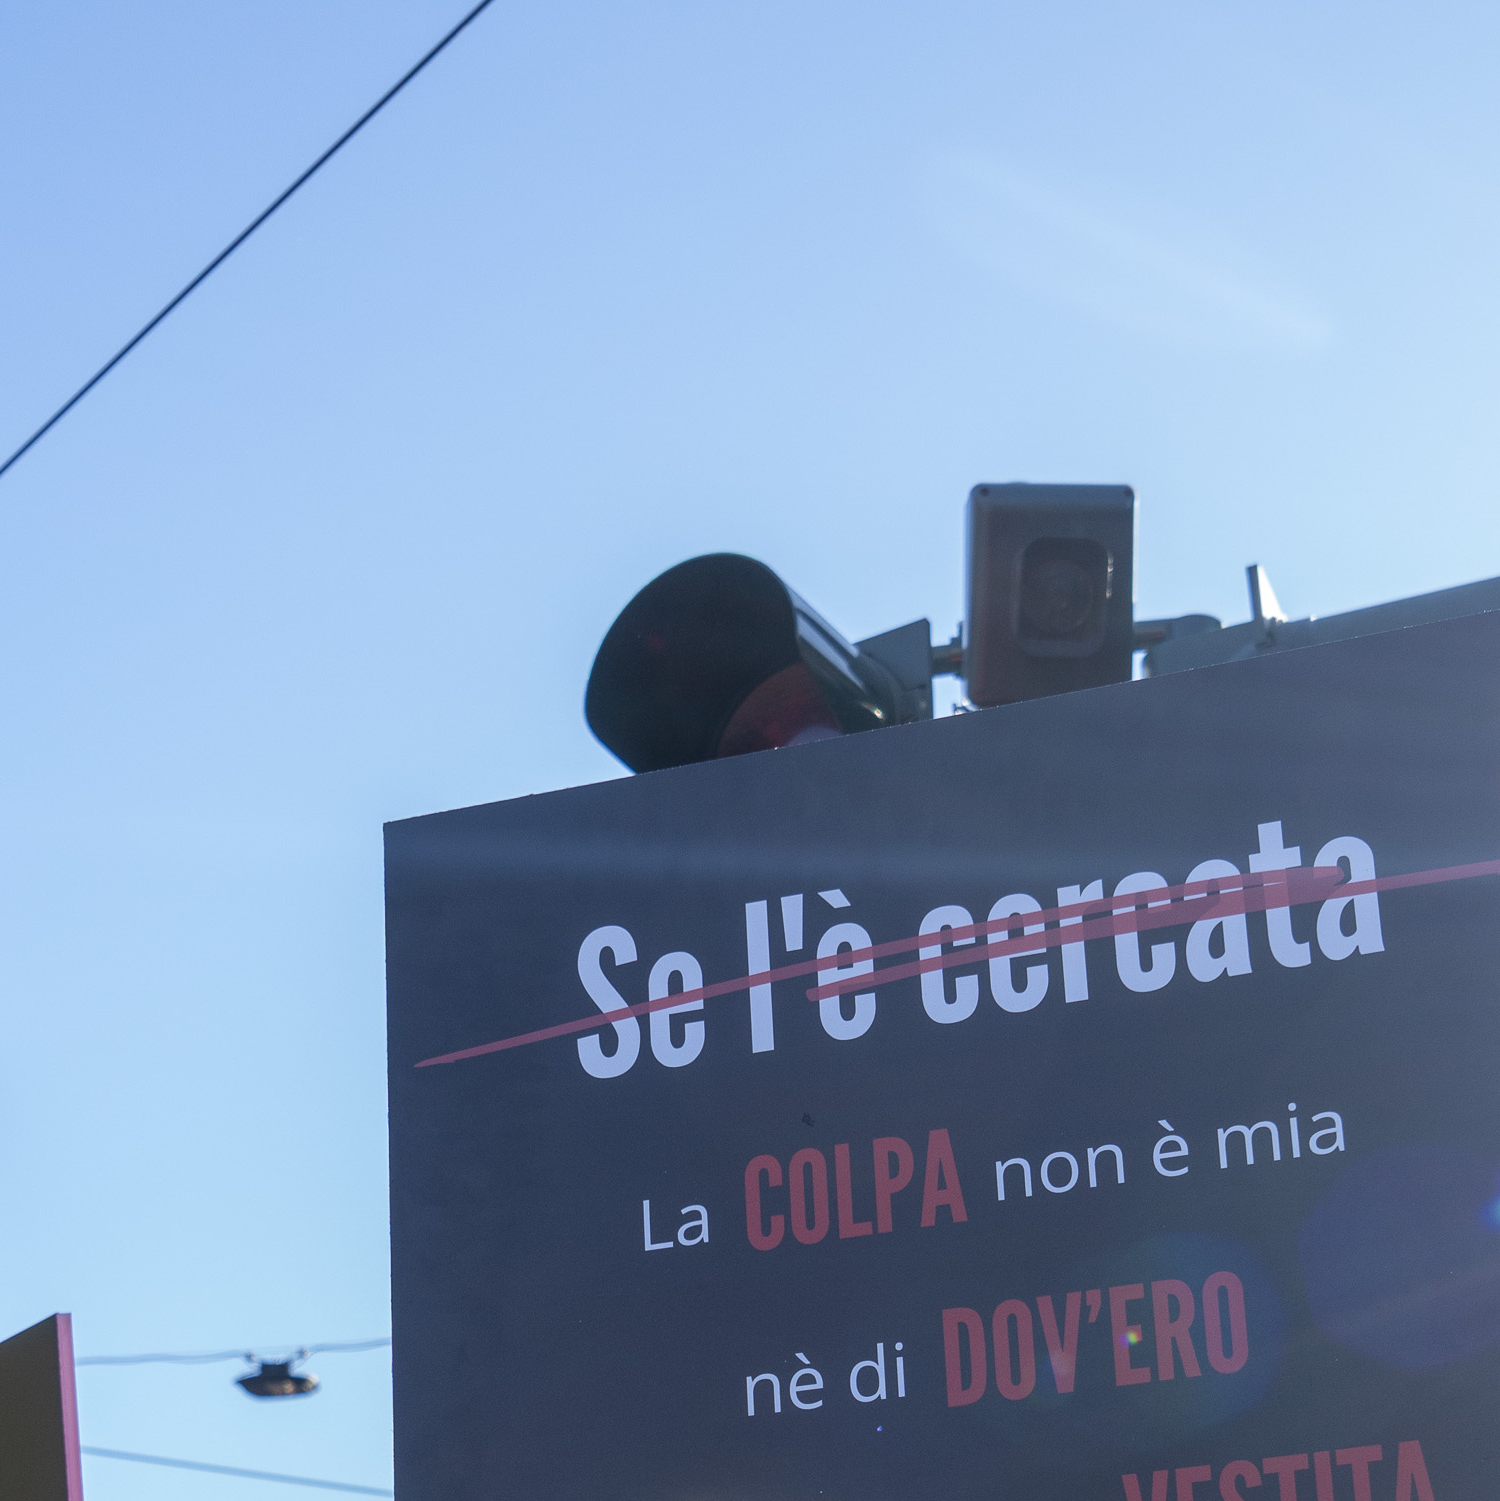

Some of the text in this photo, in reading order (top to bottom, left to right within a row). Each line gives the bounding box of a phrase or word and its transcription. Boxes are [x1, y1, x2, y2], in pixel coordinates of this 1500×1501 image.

[577, 820, 1386, 1079] Se l'è cercata
[642, 1102, 1347, 1252] La COLPA non è mia
[746, 1271, 1249, 1417] nè di DOV'ERO
